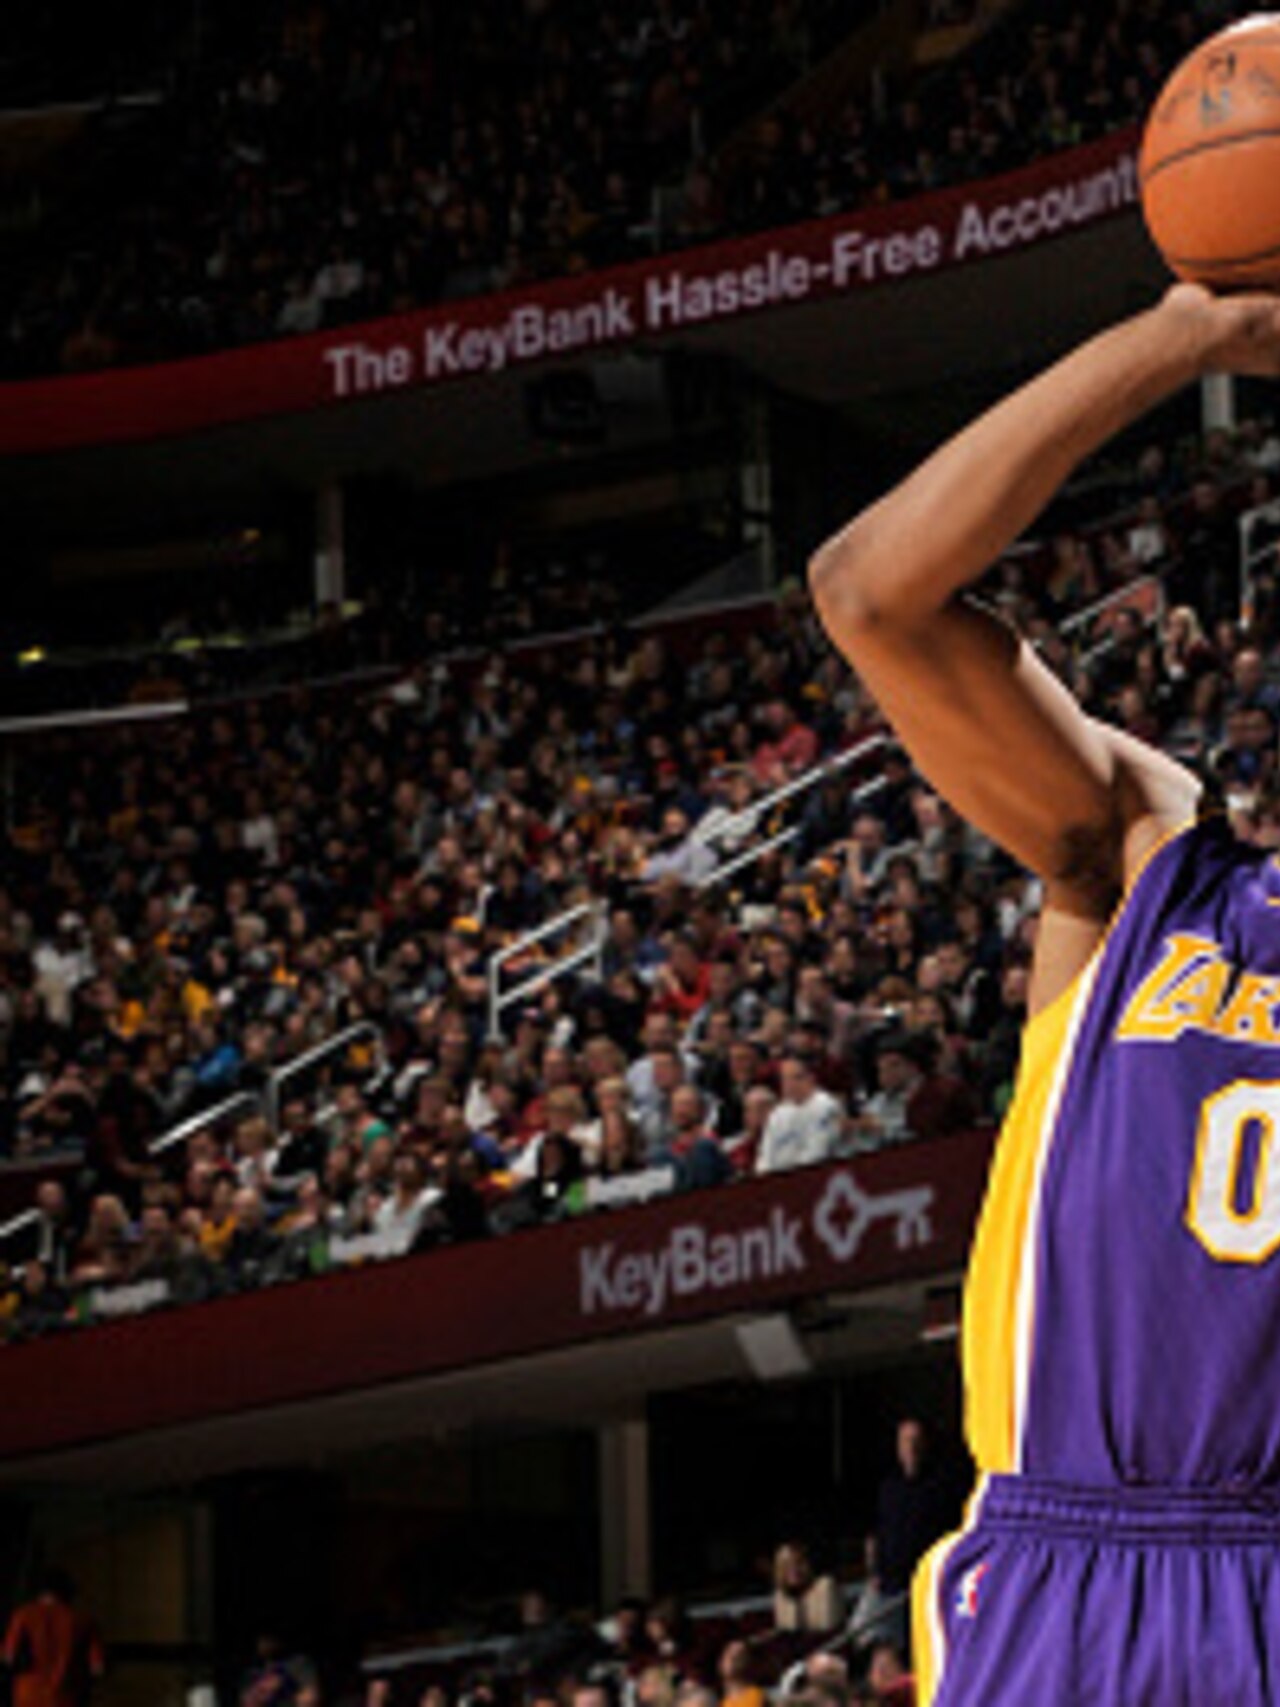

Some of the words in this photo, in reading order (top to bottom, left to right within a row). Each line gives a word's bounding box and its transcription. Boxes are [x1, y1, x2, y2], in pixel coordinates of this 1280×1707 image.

[325, 343, 410, 396] The
[424, 287, 634, 376] KeyBank
[645, 225, 940, 328] Hassle-Free
[954, 155, 1138, 260] Account
[579, 1207, 806, 1315] KeyBank
